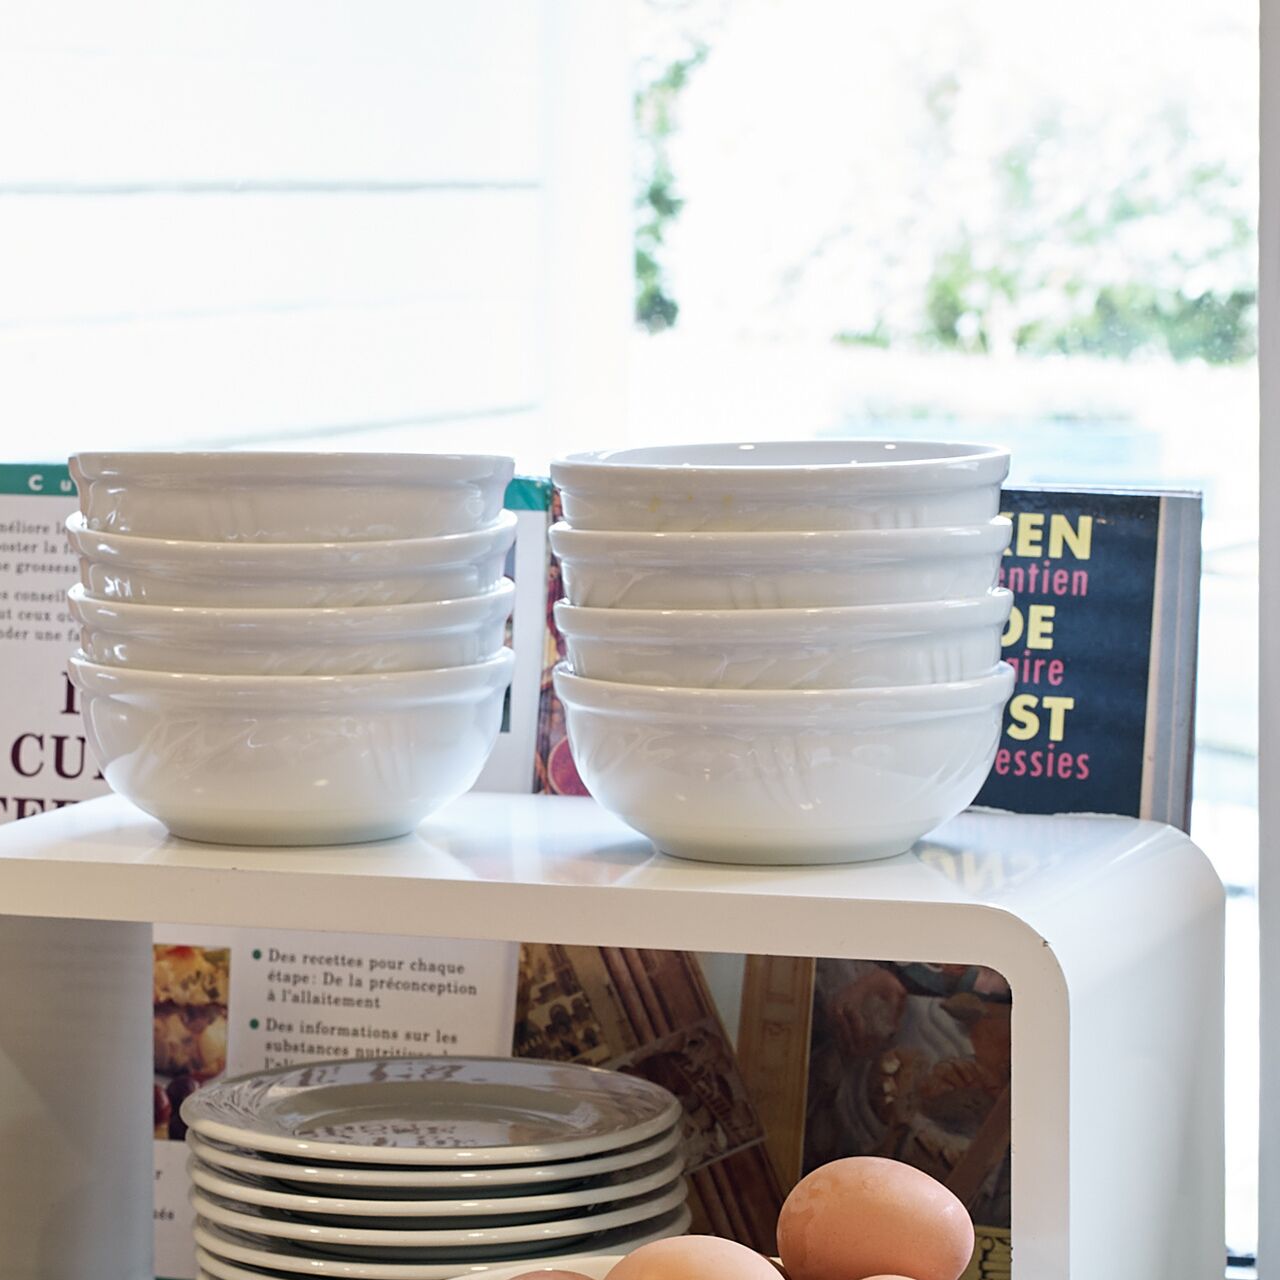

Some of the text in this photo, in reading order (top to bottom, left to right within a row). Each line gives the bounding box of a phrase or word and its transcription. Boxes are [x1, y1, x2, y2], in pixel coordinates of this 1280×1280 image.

[44, 541, 58, 554] la
[15, 563, 78, 574] grossess
[14, 588, 67, 601] conseil
[35, 630, 62, 641] une
[1006, 694, 1074, 741] ST
[11, 733, 105, 780] CU
[995, 743, 1089, 779] essies
[269, 949, 465, 976] Des recettes pour chaque
[323, 972, 342, 987] De
[348, 973, 362, 988] la
[369, 974, 477, 996] préconception
[266, 1017, 458, 1044] Des informations sur les
[265, 1039, 349, 1056] substances
